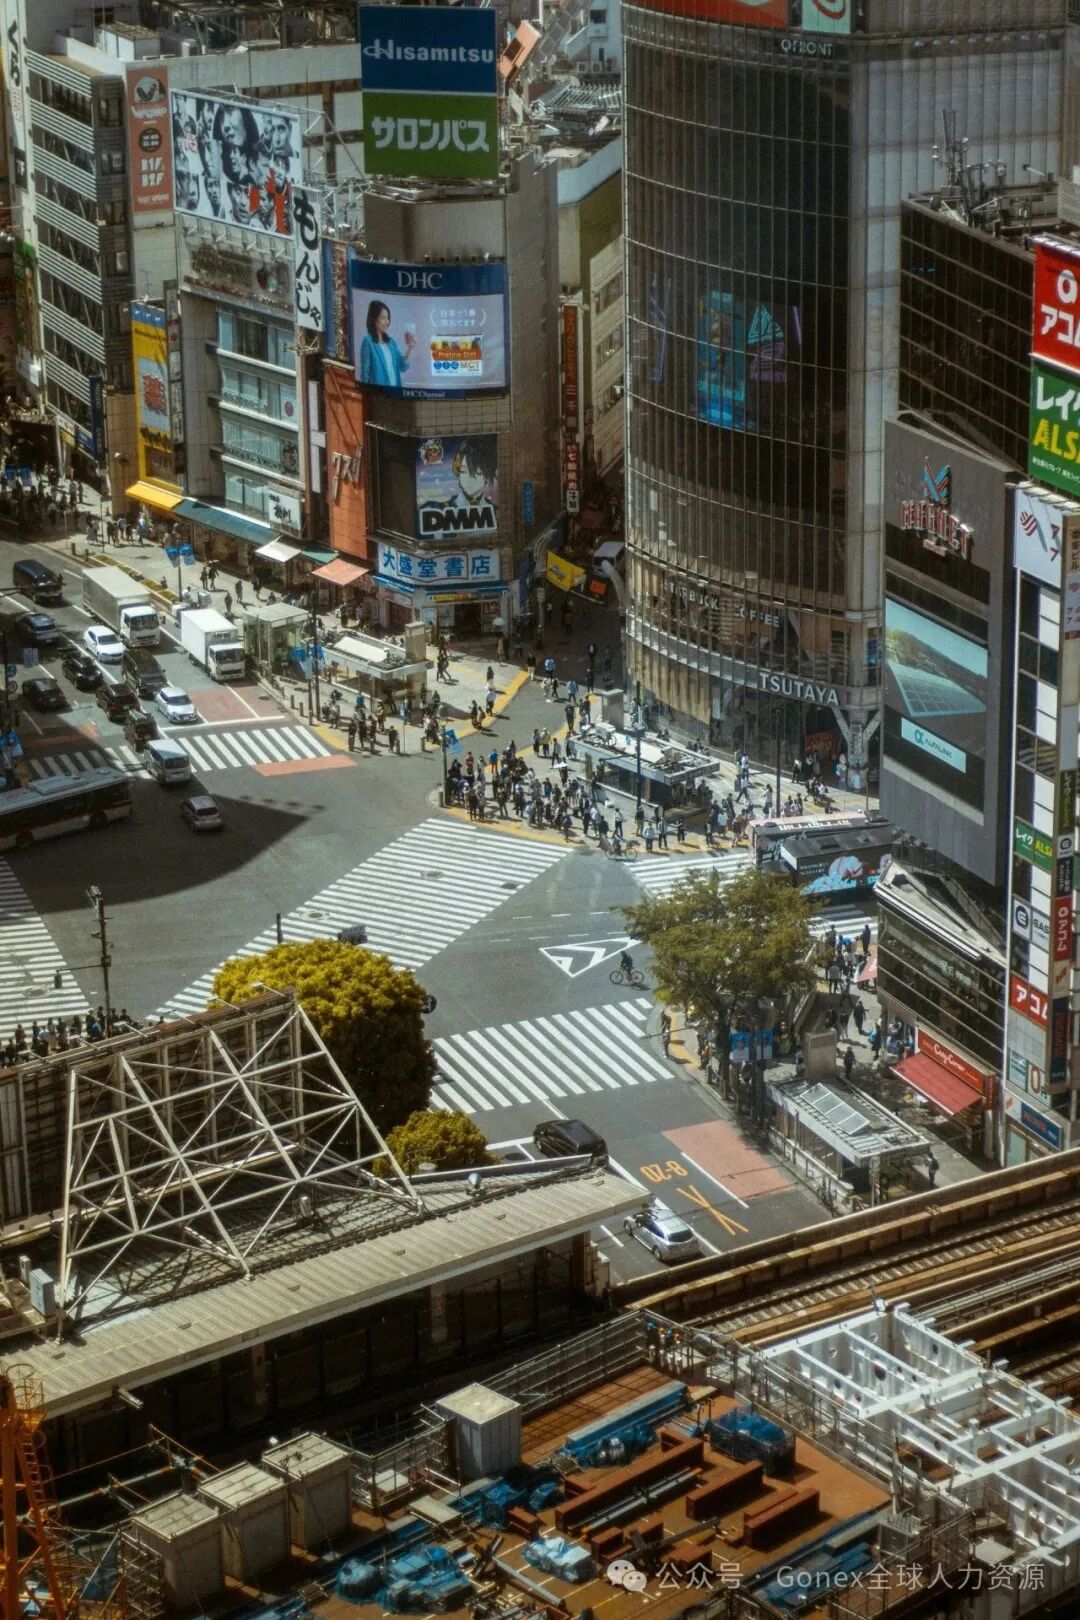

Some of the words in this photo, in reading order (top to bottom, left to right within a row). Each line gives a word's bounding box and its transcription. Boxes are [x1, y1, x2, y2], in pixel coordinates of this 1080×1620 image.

[364, 39, 494, 62] Hisamitsu
[372, 117, 489, 152] サロンパス
[397, 270, 443, 290] DHC
[421, 506, 496, 534] DMM
[383, 550, 491, 578] 大盛堂書店
[760, 671, 839, 706] TSUTAYA
[1033, 919, 1049, 934] EAS
[1057, 919, 1068, 952] アコム
